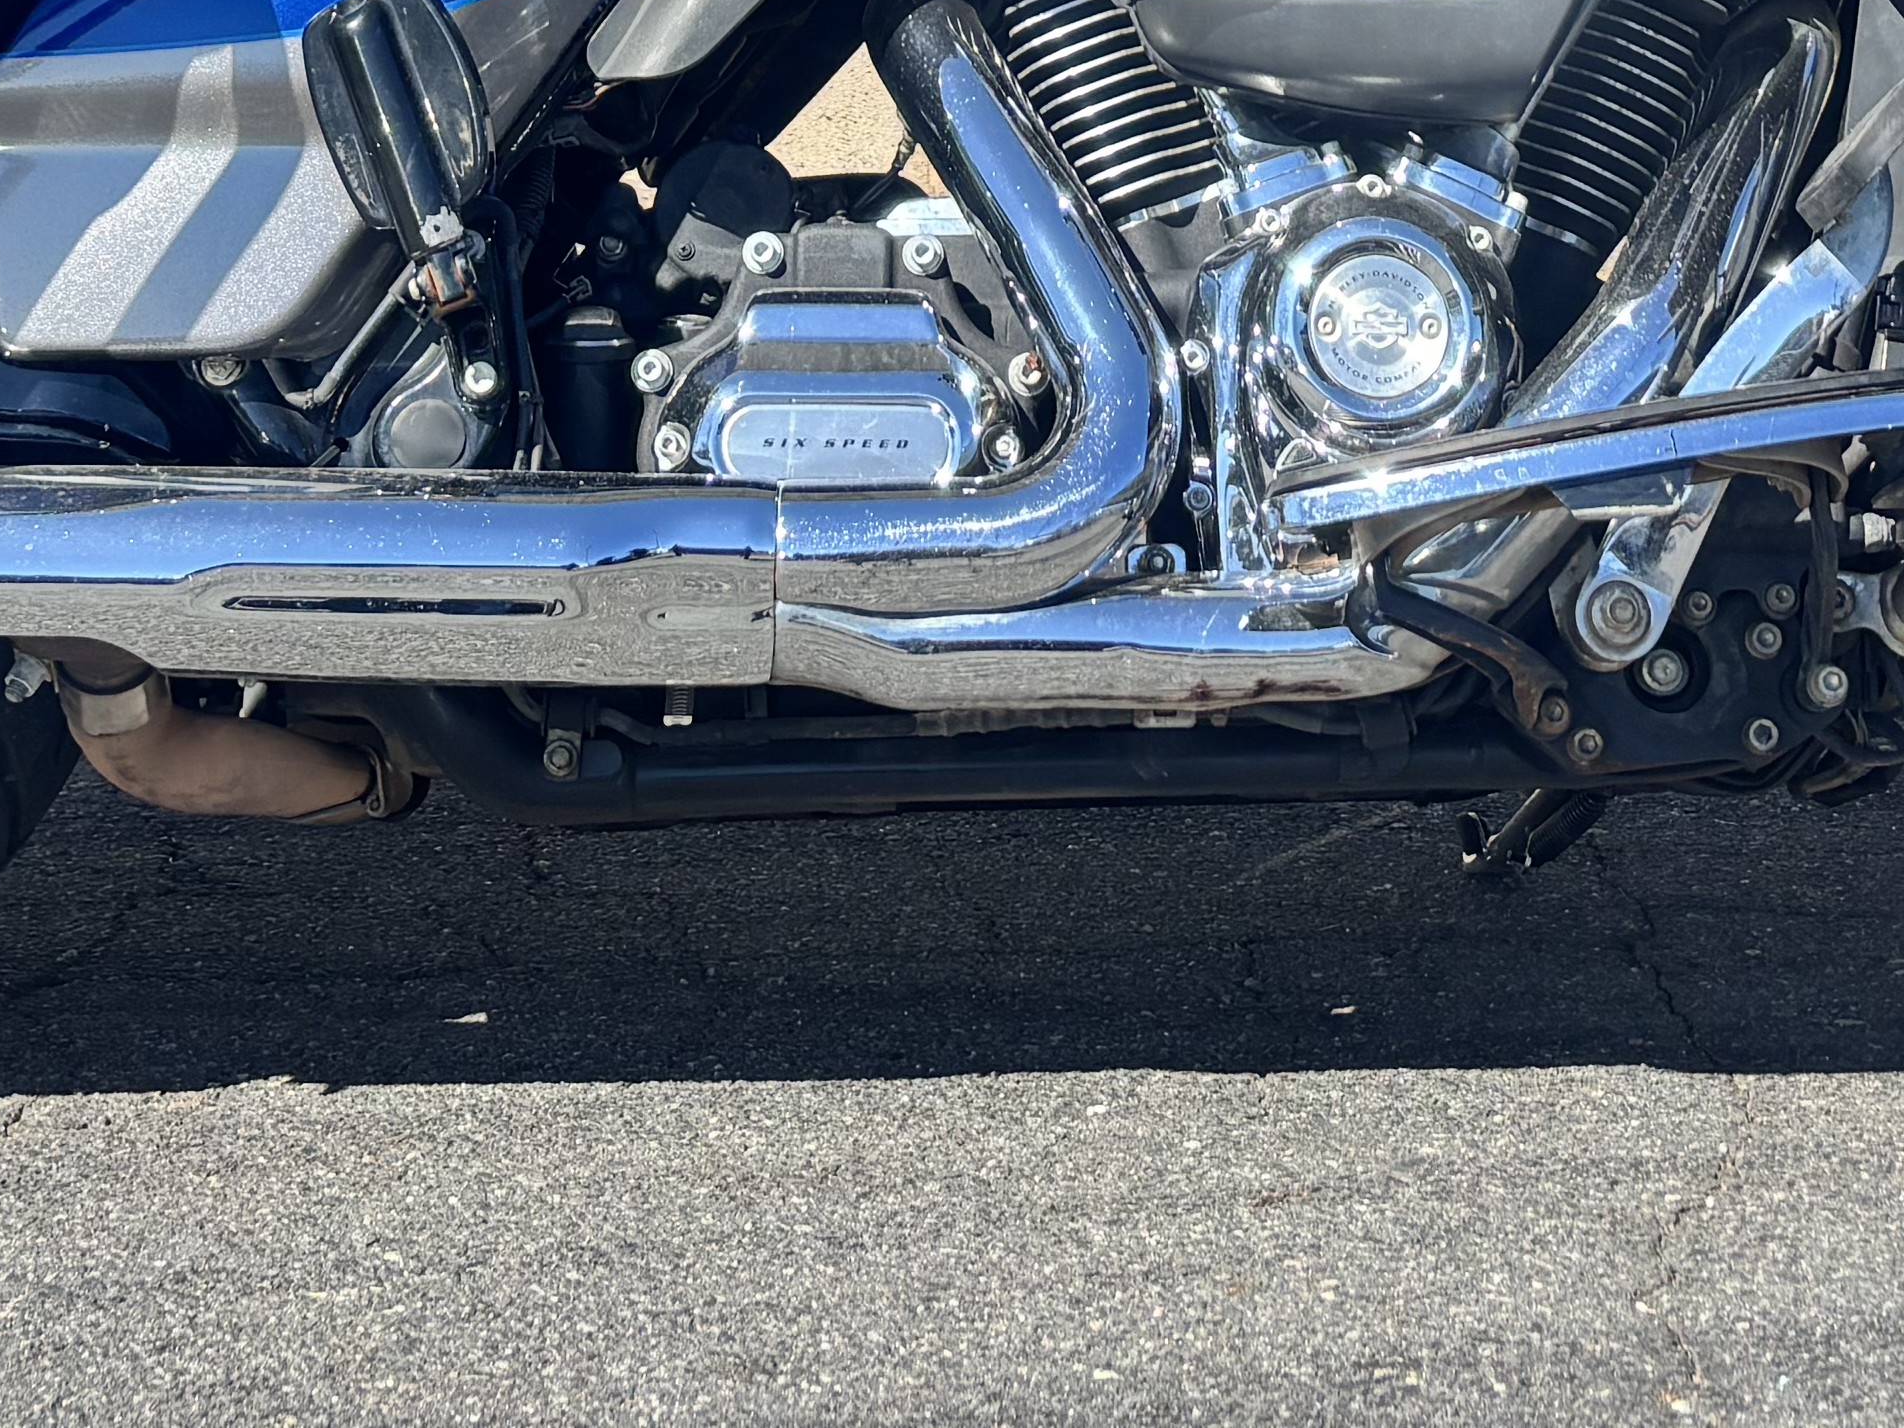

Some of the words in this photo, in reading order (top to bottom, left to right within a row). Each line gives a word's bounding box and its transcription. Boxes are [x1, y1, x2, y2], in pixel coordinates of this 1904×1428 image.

[1330, 346, 1370, 382] MOTOR
[762, 437, 807, 448] SIX
[823, 437, 910, 449] SPEED
